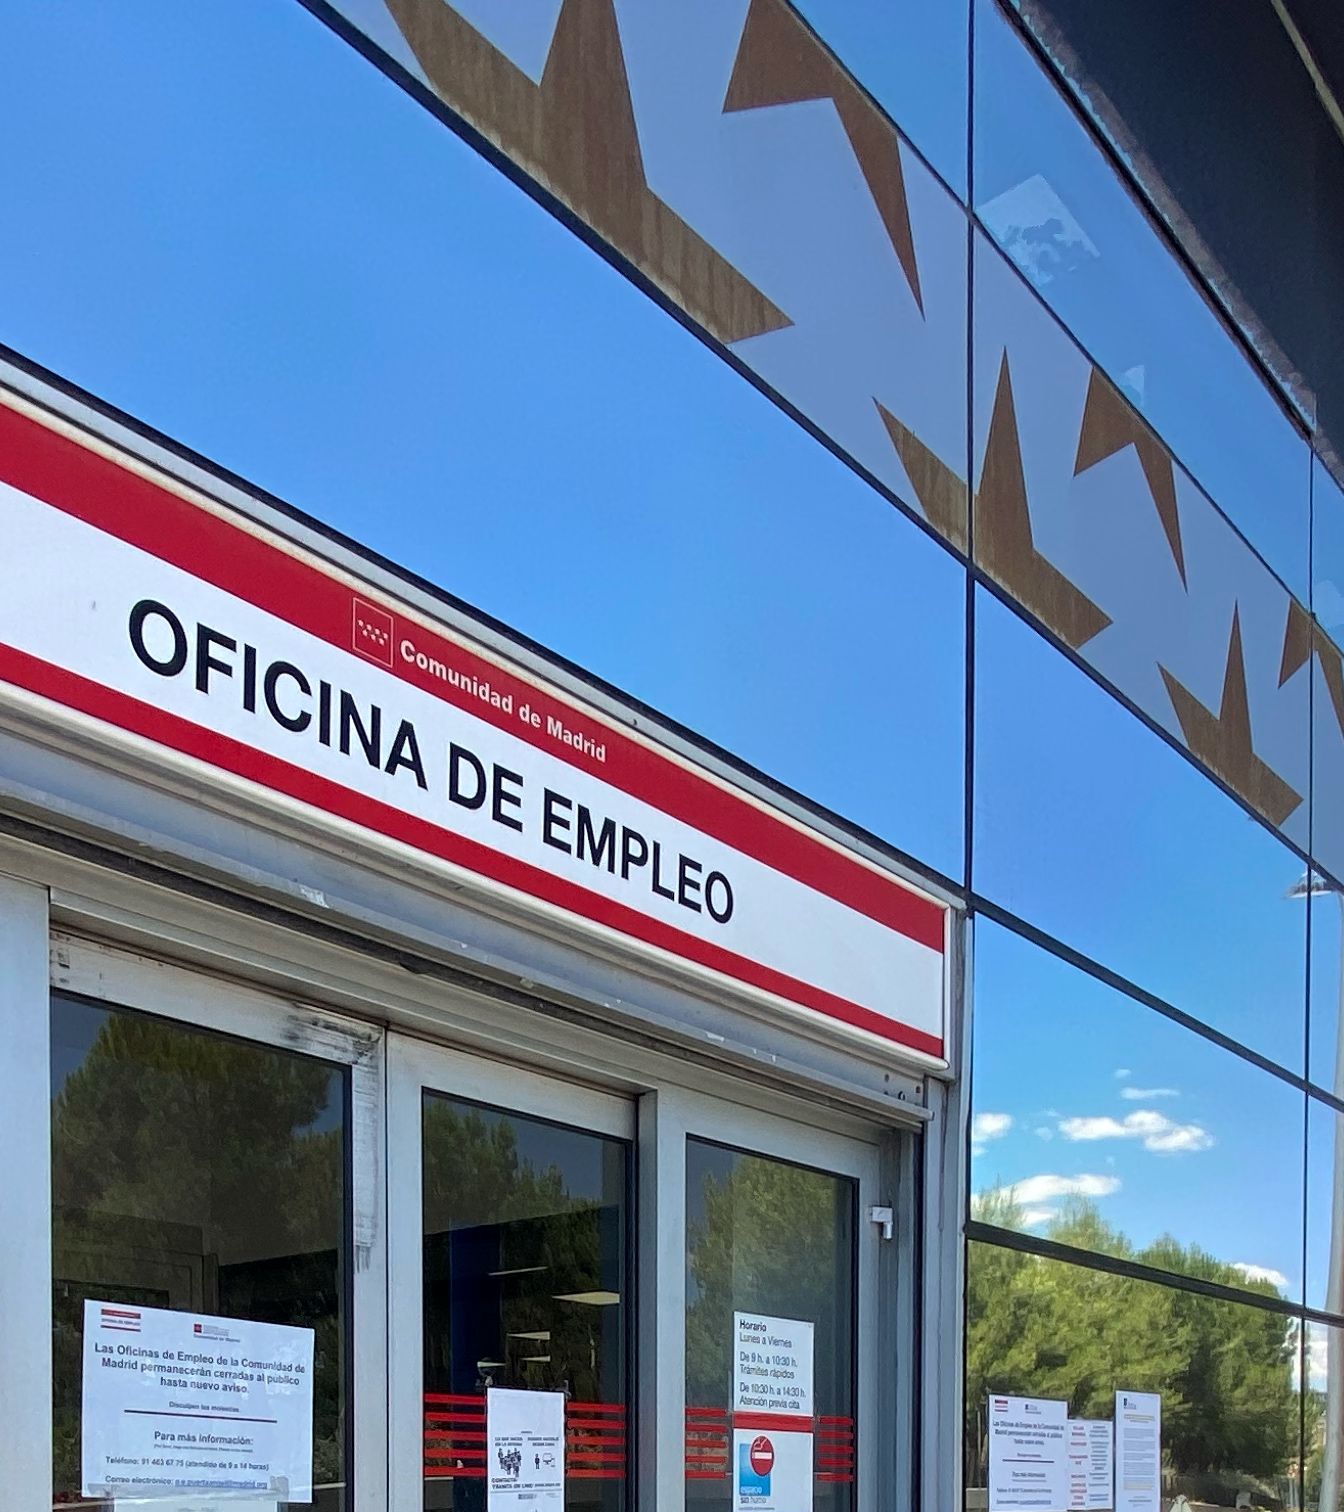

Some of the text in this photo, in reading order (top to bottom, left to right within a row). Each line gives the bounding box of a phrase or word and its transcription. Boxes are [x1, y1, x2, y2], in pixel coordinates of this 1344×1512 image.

[400, 640, 606, 763] Comunidad de Madrid
[129, 599, 734, 924] OFICINA DE EMPLEO
[739, 1319, 767, 1332] Horario
[739, 1332, 760, 1344] Lunes
[768, 1336, 792, 1348] Viernes
[95, 1342, 305, 1373] Las Oficinas de Empleo de la Comunidad de
[740, 1351, 749, 1362] De
[751, 1352, 755, 1362] 9
[772, 1355, 790, 1366] 10:30
[102, 1358, 137, 1369] Madrid
[141, 1362, 211, 1377] permanecerán
[214, 1369, 254, 1381] cerradas
[257, 1373, 264, 1381] al
[160, 1377, 187, 1387] hasta
[190, 1381, 219, 1390] nuevo
[740, 1382, 749, 1392] De
[739, 1395, 800, 1409] Atención previa cita
[154, 1431, 254, 1446] Para más información:
